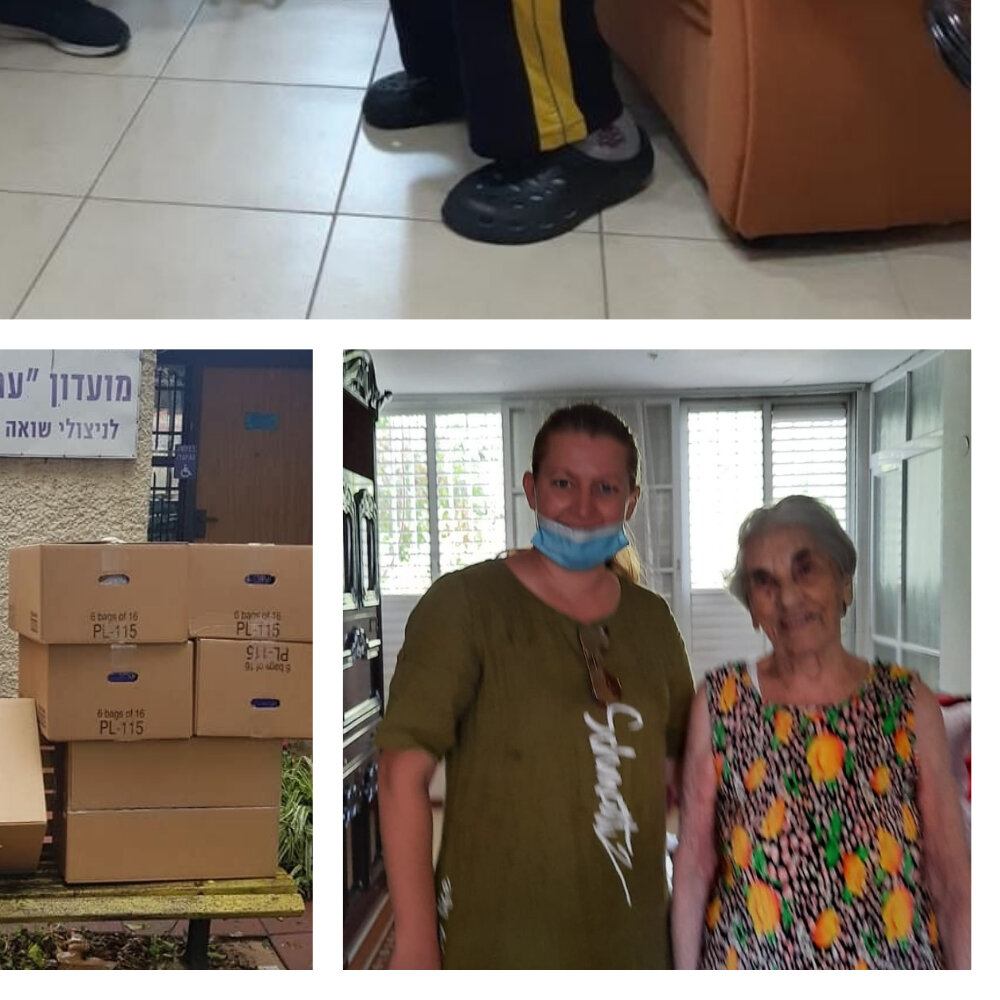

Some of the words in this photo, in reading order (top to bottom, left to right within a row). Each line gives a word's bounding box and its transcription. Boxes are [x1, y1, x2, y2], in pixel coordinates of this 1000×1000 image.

[49, 372, 132, 408] מועדון
[5, 419, 52, 439] שואה
[59, 417, 120, 440] לניצולי
[97, 611, 117, 624] bags
[118, 611, 127, 621] of
[128, 611, 139, 621] 16
[93, 623, 138, 639] PL-115
[236, 621, 280, 638] PL-115
[246, 645, 289, 662] PL-115
[104, 709, 123, 721] bags
[125, 708, 133, 718] of
[134, 709, 146, 719] 16
[100, 720, 145, 735] PL-115
